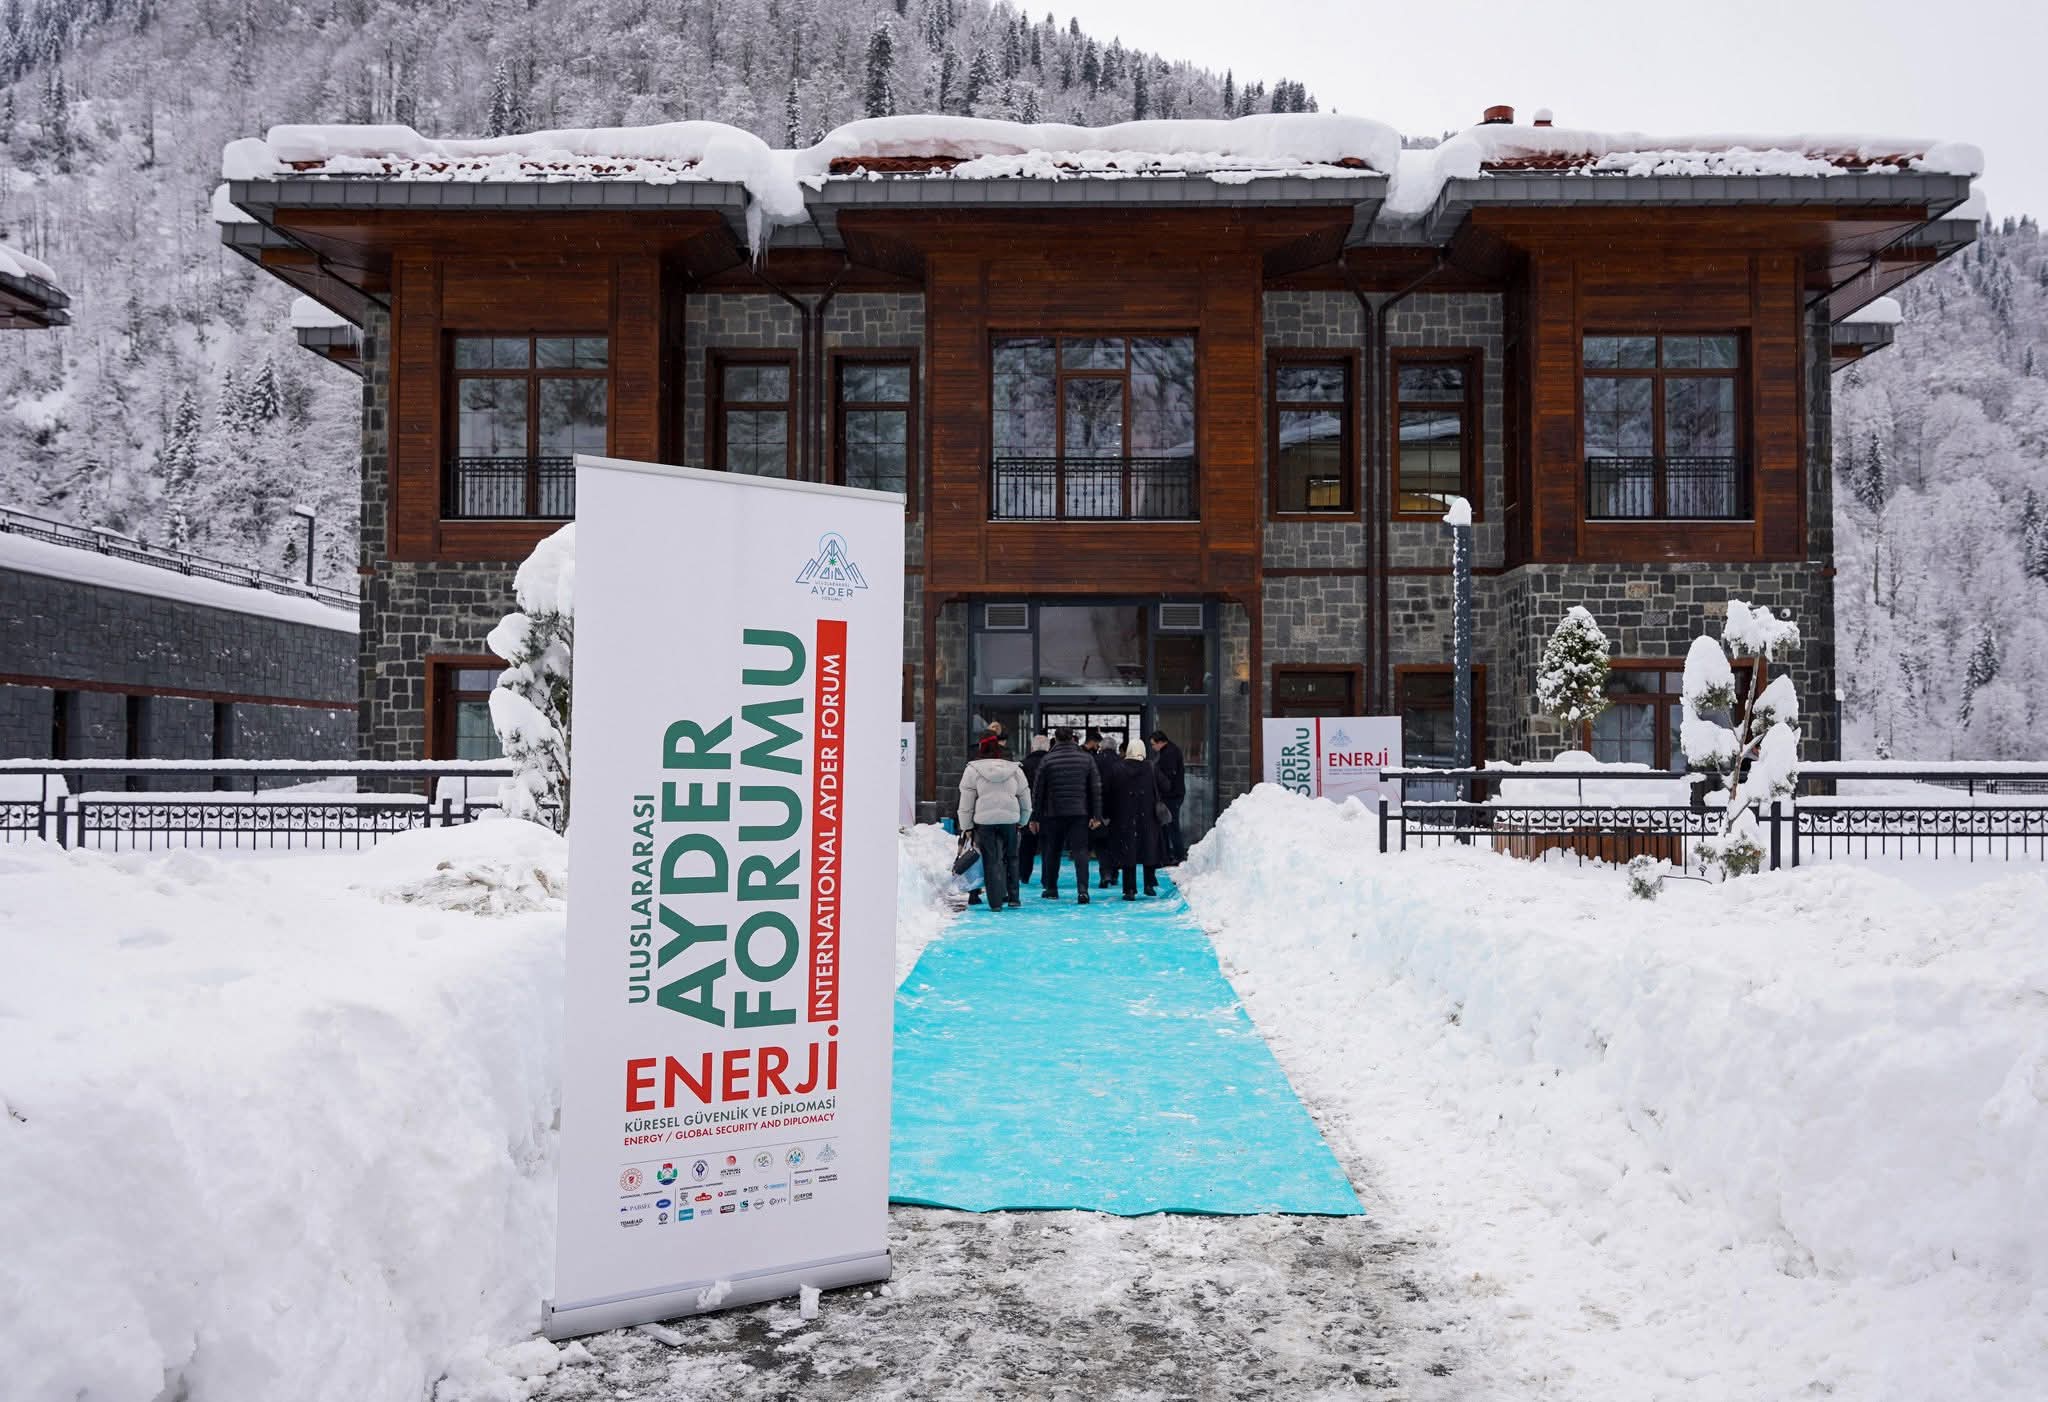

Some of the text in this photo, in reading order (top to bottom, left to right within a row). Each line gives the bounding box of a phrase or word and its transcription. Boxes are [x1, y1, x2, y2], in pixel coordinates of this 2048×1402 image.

[811, 586, 853, 597] AYDER
[1281, 746, 1297, 791] YDER
[1296, 728, 1311, 797] ORUMU
[1329, 748, 1388, 767] ENERJİ
[734, 628, 806, 1029] FORUMU
[815, 654, 840, 1016] INTERNATIONAL AYDER FORUM
[629, 794, 655, 1004] ULUSLARARASI
[657, 716, 733, 1028] AYDER
[625, 1024, 839, 1113] ENERJİ
[624, 1096, 836, 1134] KÜRESEL GÜVENLİK VE DİPLOMASİ
[624, 1113, 835, 1146] ENERGY / GLOBAL SECURITY AND DIPLOMACY
